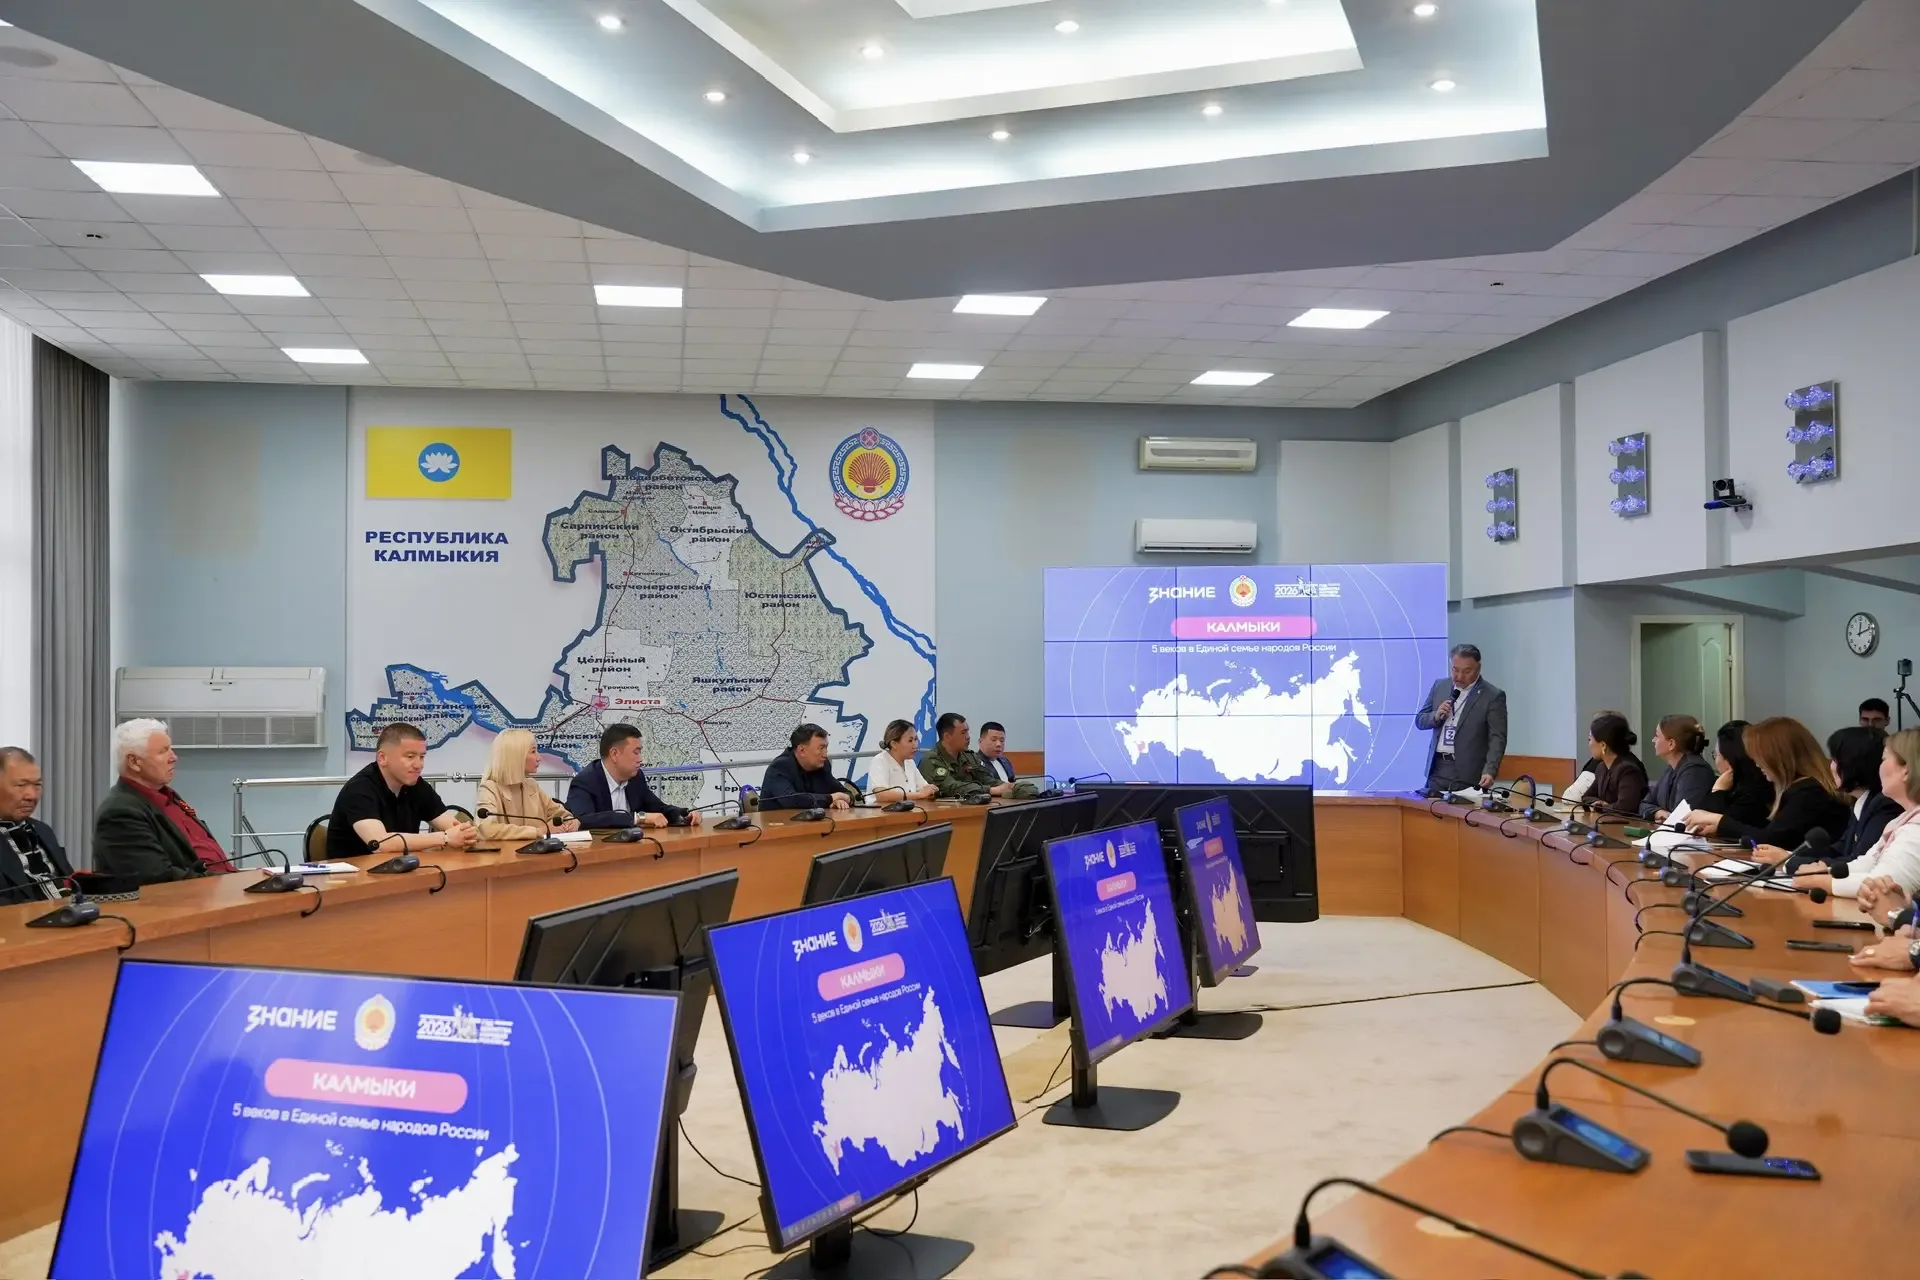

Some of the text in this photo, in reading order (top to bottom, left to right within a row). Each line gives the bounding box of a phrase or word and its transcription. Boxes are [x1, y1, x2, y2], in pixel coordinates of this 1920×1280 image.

[560, 522, 640, 531] Сарпинский
[365, 531, 509, 544] РЕСПУБЛИКА
[580, 532, 620, 540] район
[691, 535, 730, 543] район
[374, 549, 499, 563] КАЛМЫКИЯ
[606, 582, 711, 592] Кетченеровский
[1274, 586, 1298, 596] 2026
[639, 592, 679, 600] район
[745, 592, 817, 600] Юстинский
[761, 601, 800, 609] район
[1206, 621, 1281, 633] КАЛМЫКИ
[1151, 643, 1337, 654] 5 веков в Единой семье народов России
[577, 656, 646, 665] Целинный
[592, 666, 631, 674] район
[692, 676, 772, 684] Яшкульский
[712, 685, 752, 693] район
[398, 703, 491, 711] Яшалтинский
[424, 713, 465, 721] район
[840, 964, 886, 989] КАЛМЫКИ
[811, 1012, 818, 1024] 5
[901, 982, 921, 997] России
[416, 1018, 452, 1037] 2026
[312, 1072, 416, 1099] КАЛМЫКИ
[232, 1102, 490, 1141] 5 веков в Единой семье народов России
